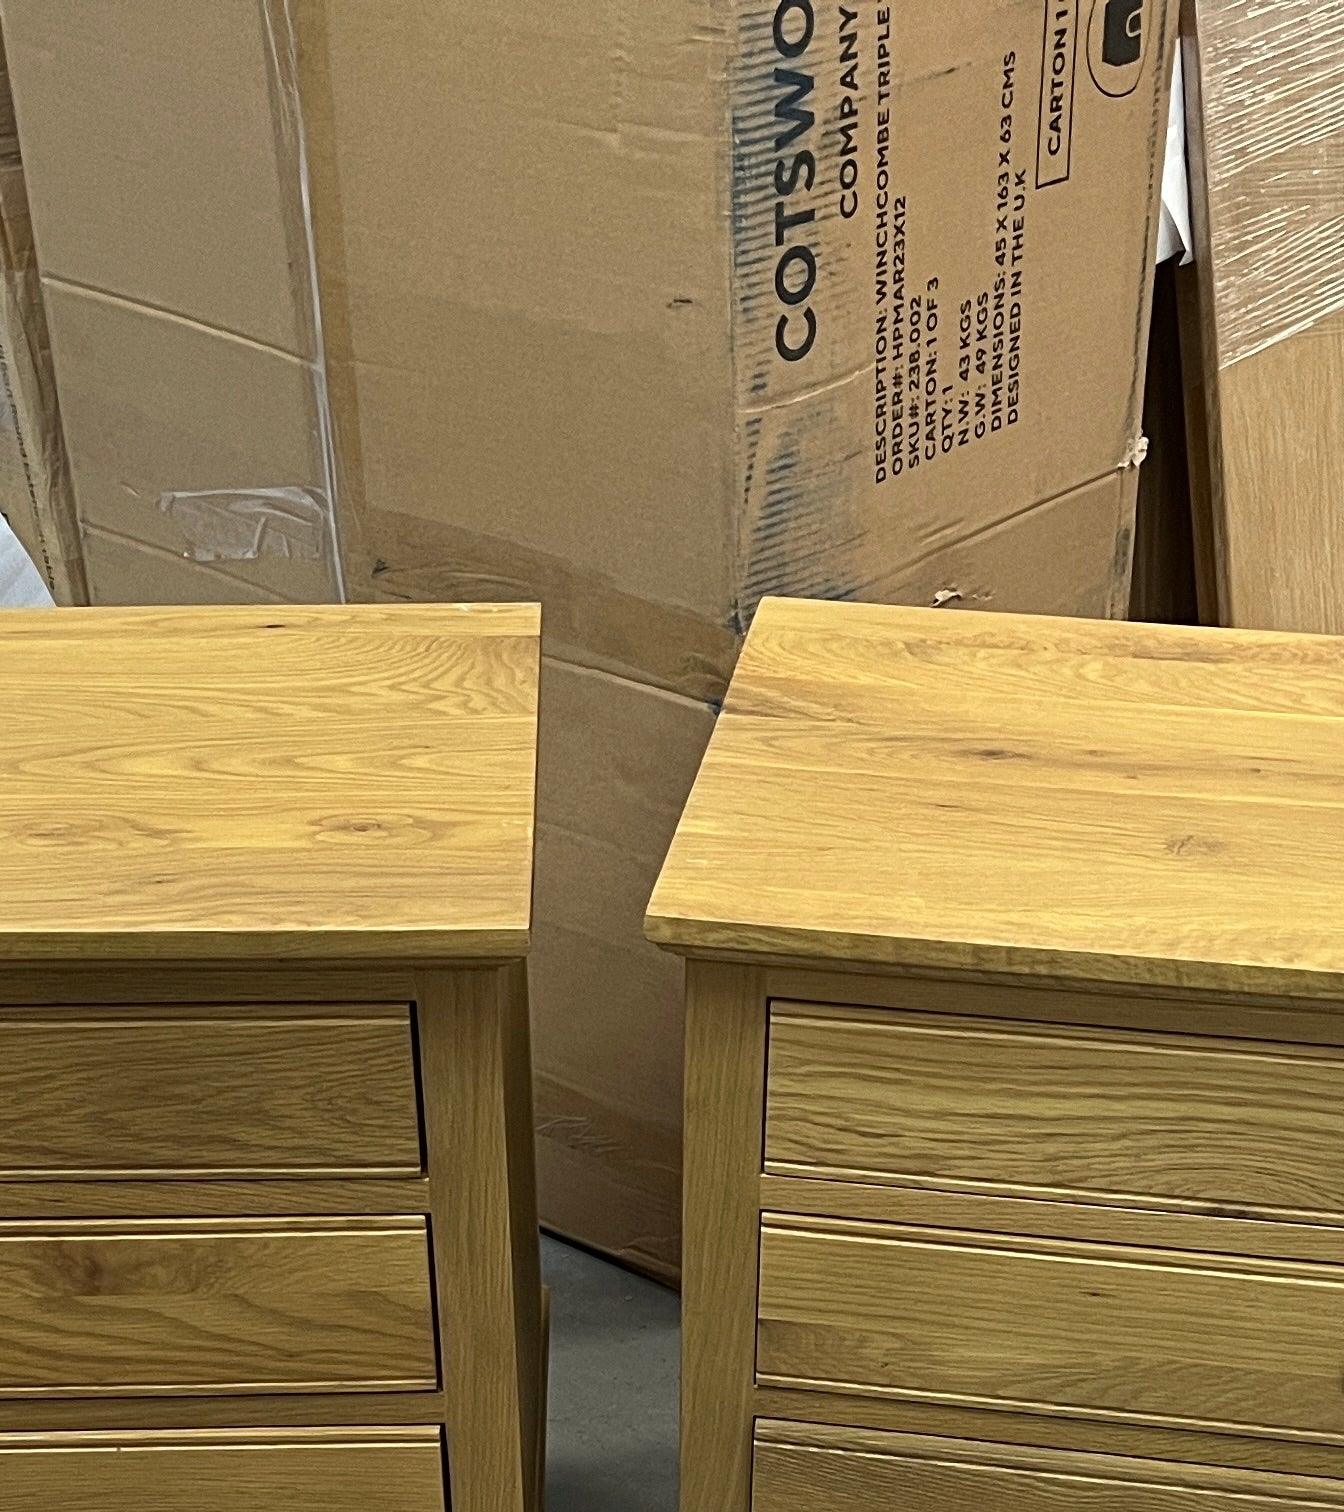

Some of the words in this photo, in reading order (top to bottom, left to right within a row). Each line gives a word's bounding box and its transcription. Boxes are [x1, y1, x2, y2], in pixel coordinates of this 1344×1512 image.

[877, 6, 890, 105] TRIPLE
[1001, 50, 1016, 109] CMS
[839, 6, 859, 218] COMPANY
[1047, 27, 1067, 157] CARTON
[999, 114, 1012, 143] 63
[875, 108, 890, 306] WINCHCOMBE
[997, 172, 1009, 211] 163
[1013, 168, 1027, 211] U.K
[995, 238, 1007, 267] 45
[1011, 213, 1025, 267] THE
[892, 196, 906, 361] HPMAR23X12
[926, 276, 939, 290] 3
[1010, 270, 1023, 297] IN
[909, 294, 922, 391] 238.002
[926, 297, 938, 333] OF
[959, 299, 972, 350] KGS
[975, 291, 989, 342] KGS
[959, 354, 971, 382] 43
[975, 348, 987, 375] 49
[991, 271, 1006, 432] DIMENSIONS:
[1008, 301, 1021, 425] DESIGNED
[875, 307, 888, 484] DESCRIPTION:
[891, 364, 905, 476] ORDER#:
[924, 351, 938, 461] CARTON:
[958, 390, 970, 446] N.W:
[974, 383, 986, 439] G.W:
[908, 394, 920, 469] SKU#:
